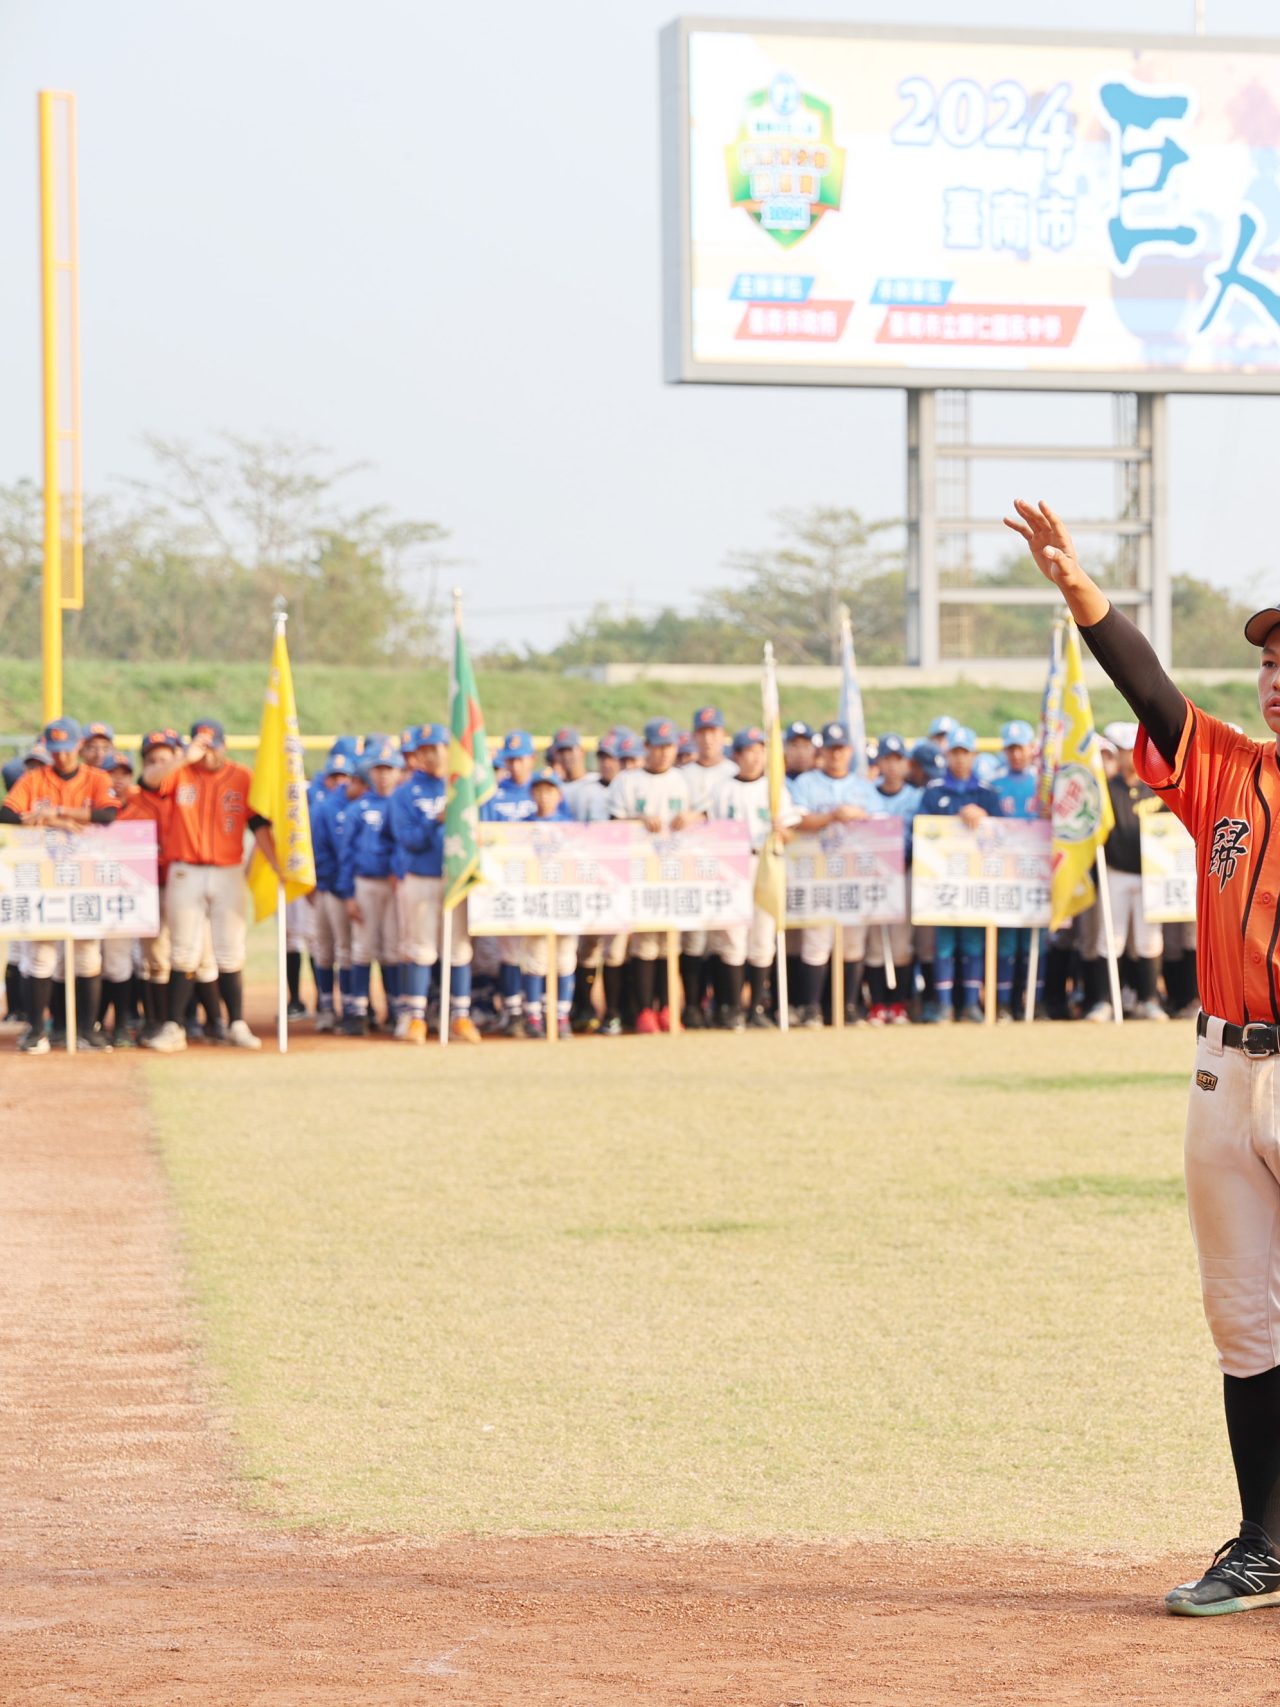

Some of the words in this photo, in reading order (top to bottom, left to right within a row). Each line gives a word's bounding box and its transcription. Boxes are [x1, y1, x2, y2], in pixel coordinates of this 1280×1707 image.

[891, 75, 1076, 175] 2024
[943, 186, 1077, 252] 臺南市
[493, 888, 611, 919] 金城國中
[935, 884, 1050, 912] 安順國中
